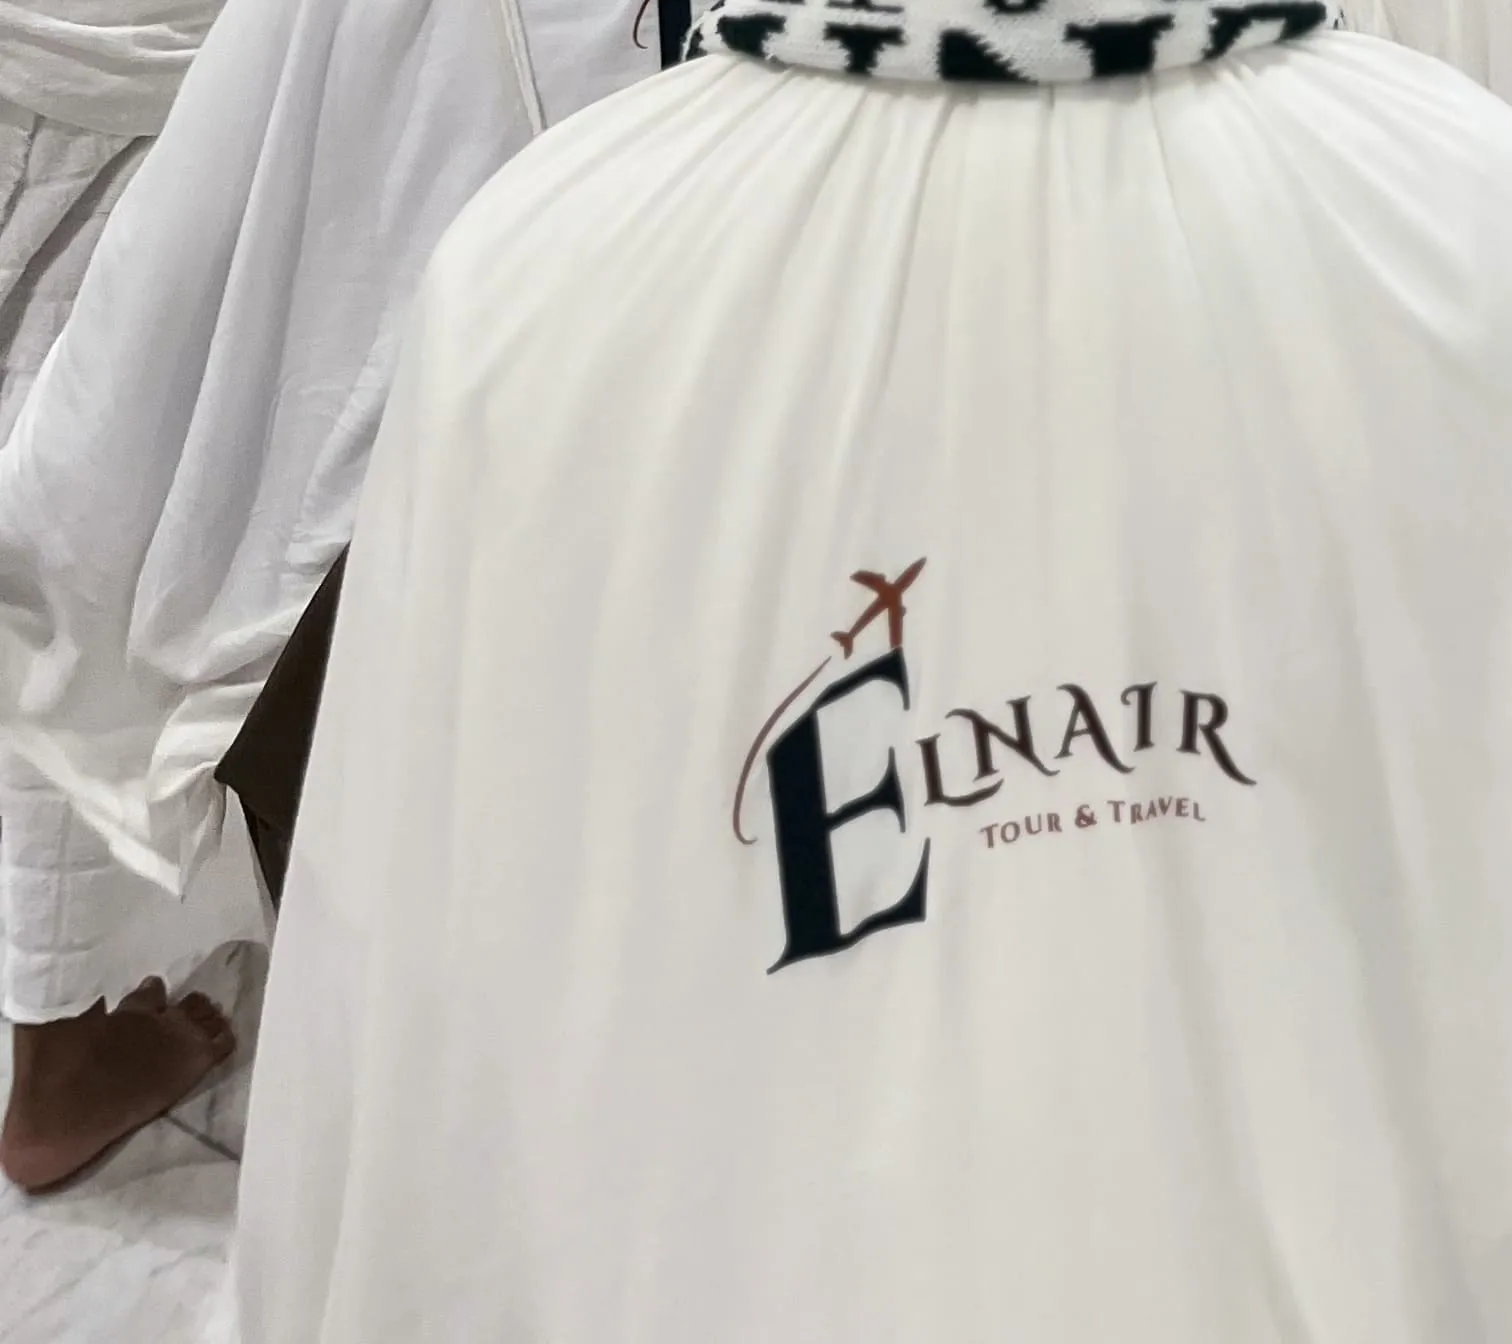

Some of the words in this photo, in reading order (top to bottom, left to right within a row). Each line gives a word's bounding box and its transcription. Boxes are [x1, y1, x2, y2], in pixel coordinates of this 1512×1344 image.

[767, 647, 1257, 975] ELNAIR
[979, 812, 1063, 849] TOUR
[1074, 804, 1098, 830] &
[1106, 794, 1207, 826] TRAVEL
